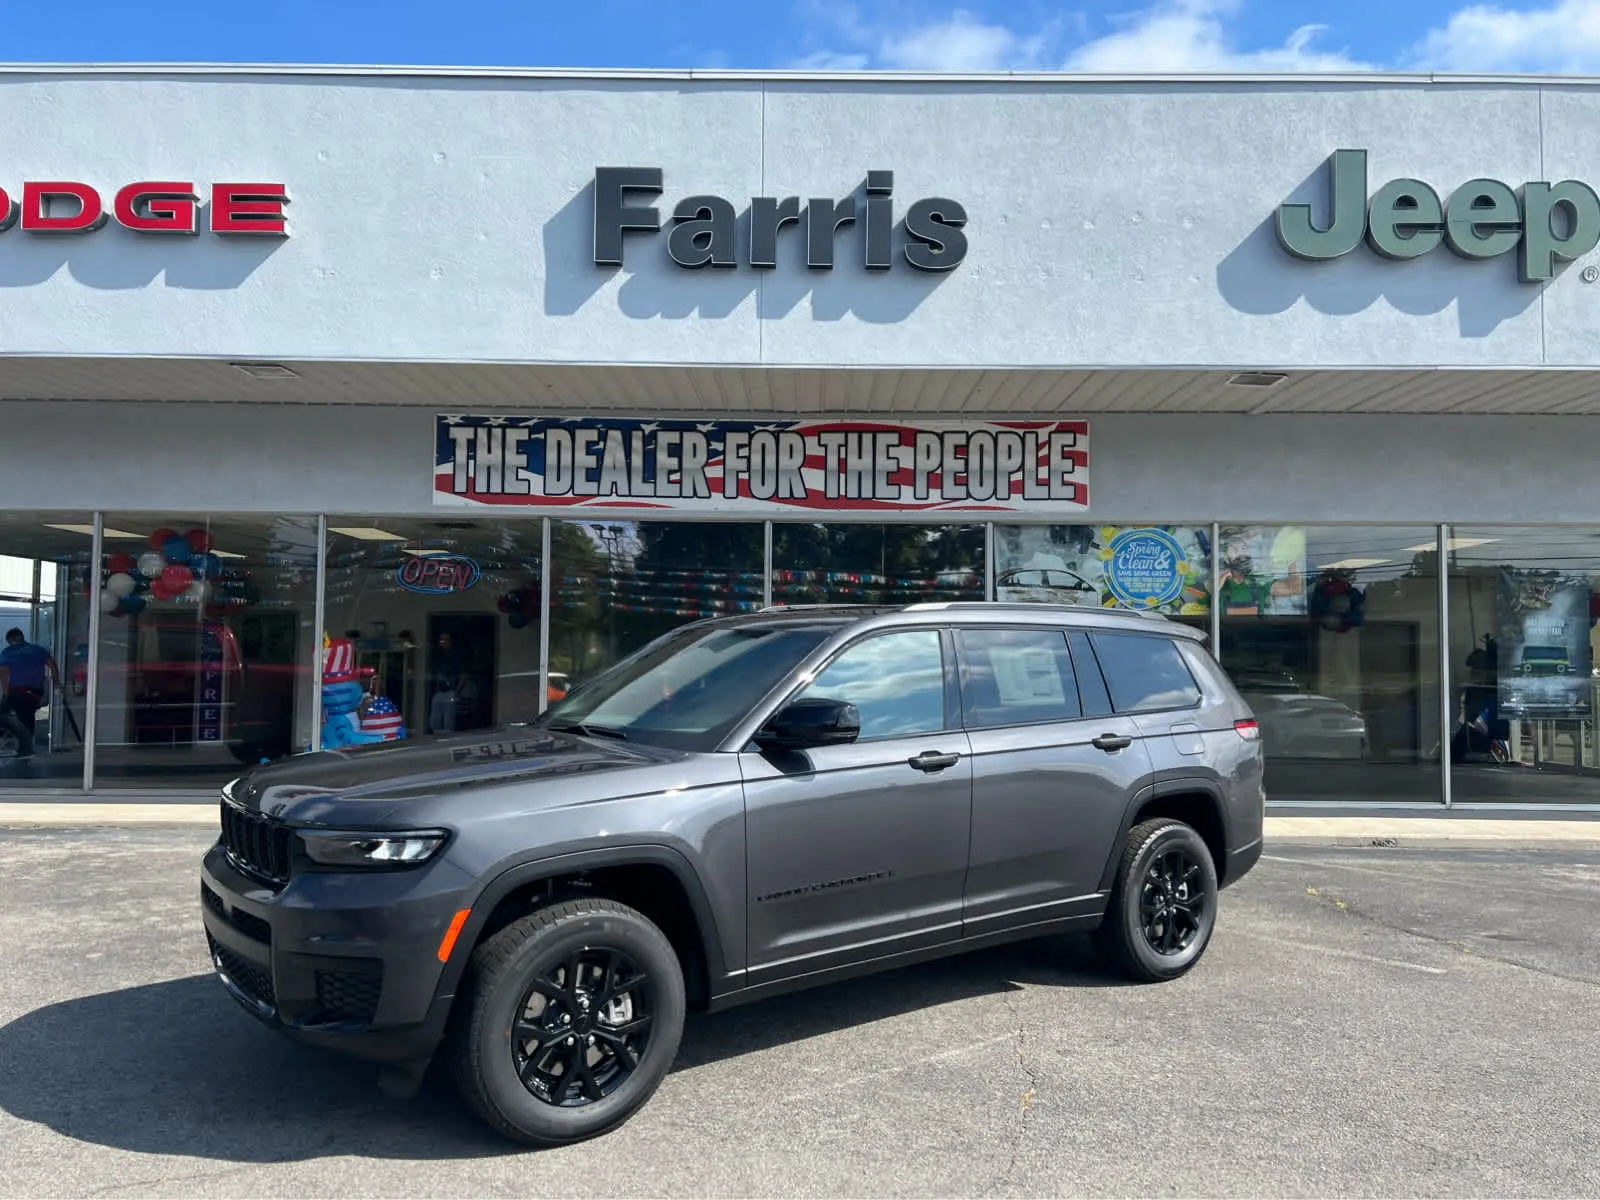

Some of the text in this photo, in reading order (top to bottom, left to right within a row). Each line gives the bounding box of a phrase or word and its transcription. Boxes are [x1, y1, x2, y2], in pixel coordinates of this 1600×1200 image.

[0, 181, 290, 239] DGE
[593, 166, 969, 272] Farris
[1276, 148, 1600, 282] Jeep
[449, 424, 1077, 501] THE DEALER FOR THE PEOPLE
[403, 556, 472, 592] OPEN
[1117, 549, 1171, 570] Clean &
[1128, 541, 1161, 558] Spring
